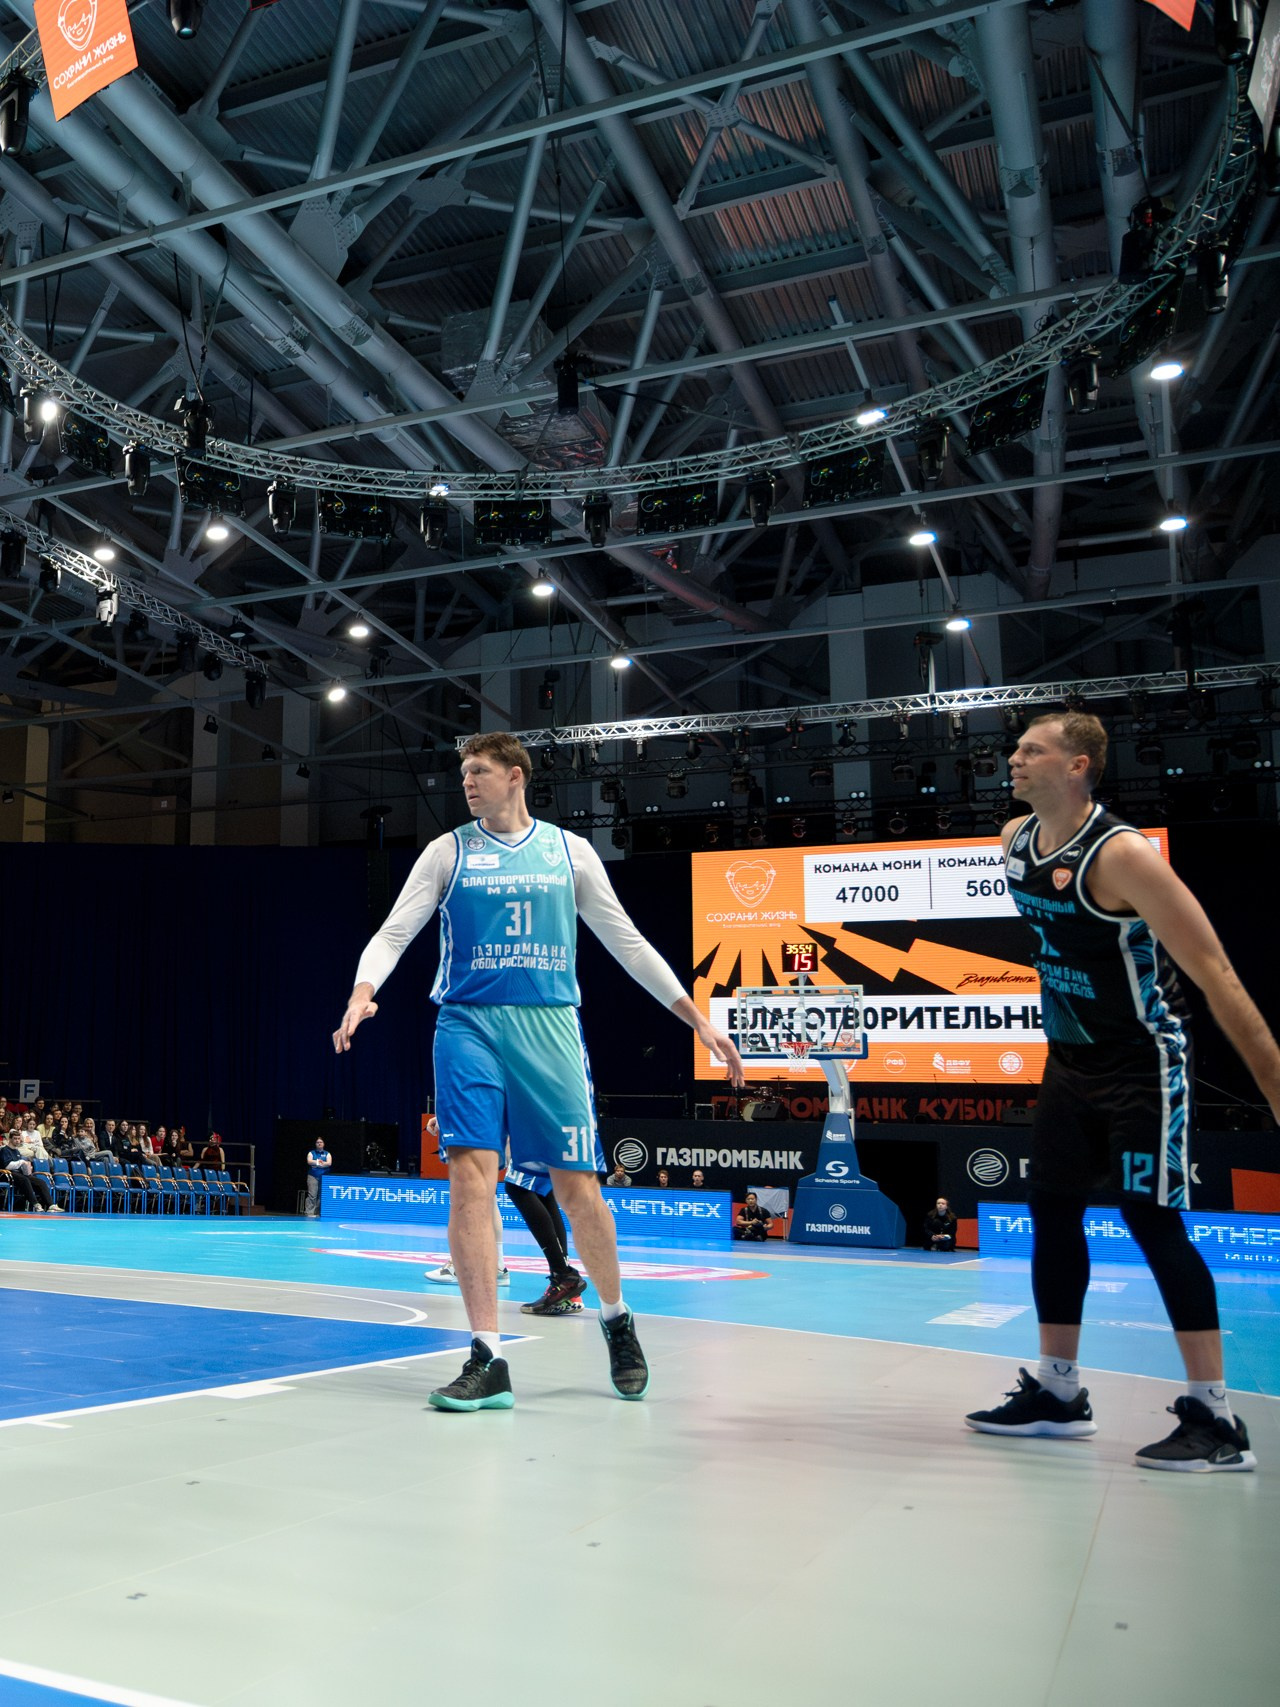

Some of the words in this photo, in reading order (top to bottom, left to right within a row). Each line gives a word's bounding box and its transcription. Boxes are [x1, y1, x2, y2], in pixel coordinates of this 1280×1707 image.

[53, 51, 93, 89] СОХРАНИ
[92, 31, 127, 60] ЖИЗНЬ
[814, 861, 878, 874] КОМАНДА
[883, 859, 922, 870] МОНИ
[938, 856, 1005, 868] КОМАНДА
[462, 873, 567, 888] БЛАГОТВОРИТЕЛЬНЫЙ
[966, 879, 1008, 897] 560
[487, 885, 548, 895] МАТЧ
[836, 885, 899, 903] 47000
[505, 901, 531, 936] 31
[706, 912, 758, 922] СОХРАНИ
[760, 911, 798, 920] ЖИЗНЬ
[472, 943, 566, 958] ГАЗПРОМБАНК
[500, 956, 537, 969] РОССИИ
[537, 959, 566, 972] 25/26
[794, 954, 811, 971] 15
[956, 971, 1037, 989] Владивосток
[24, 1083, 36, 1098] F
[562, 1126, 589, 1162] 31
[657, 1147, 804, 1170] ГАЗПРОМБАНК
[1122, 1152, 1153, 1193] 12
[329, 1185, 436, 1204] ТИТУЛЬНЫЙ
[621, 1199, 720, 1218] ЧЕТЫРЕХ
[805, 1223, 871, 1235] ГАЗПРОМБАНК
